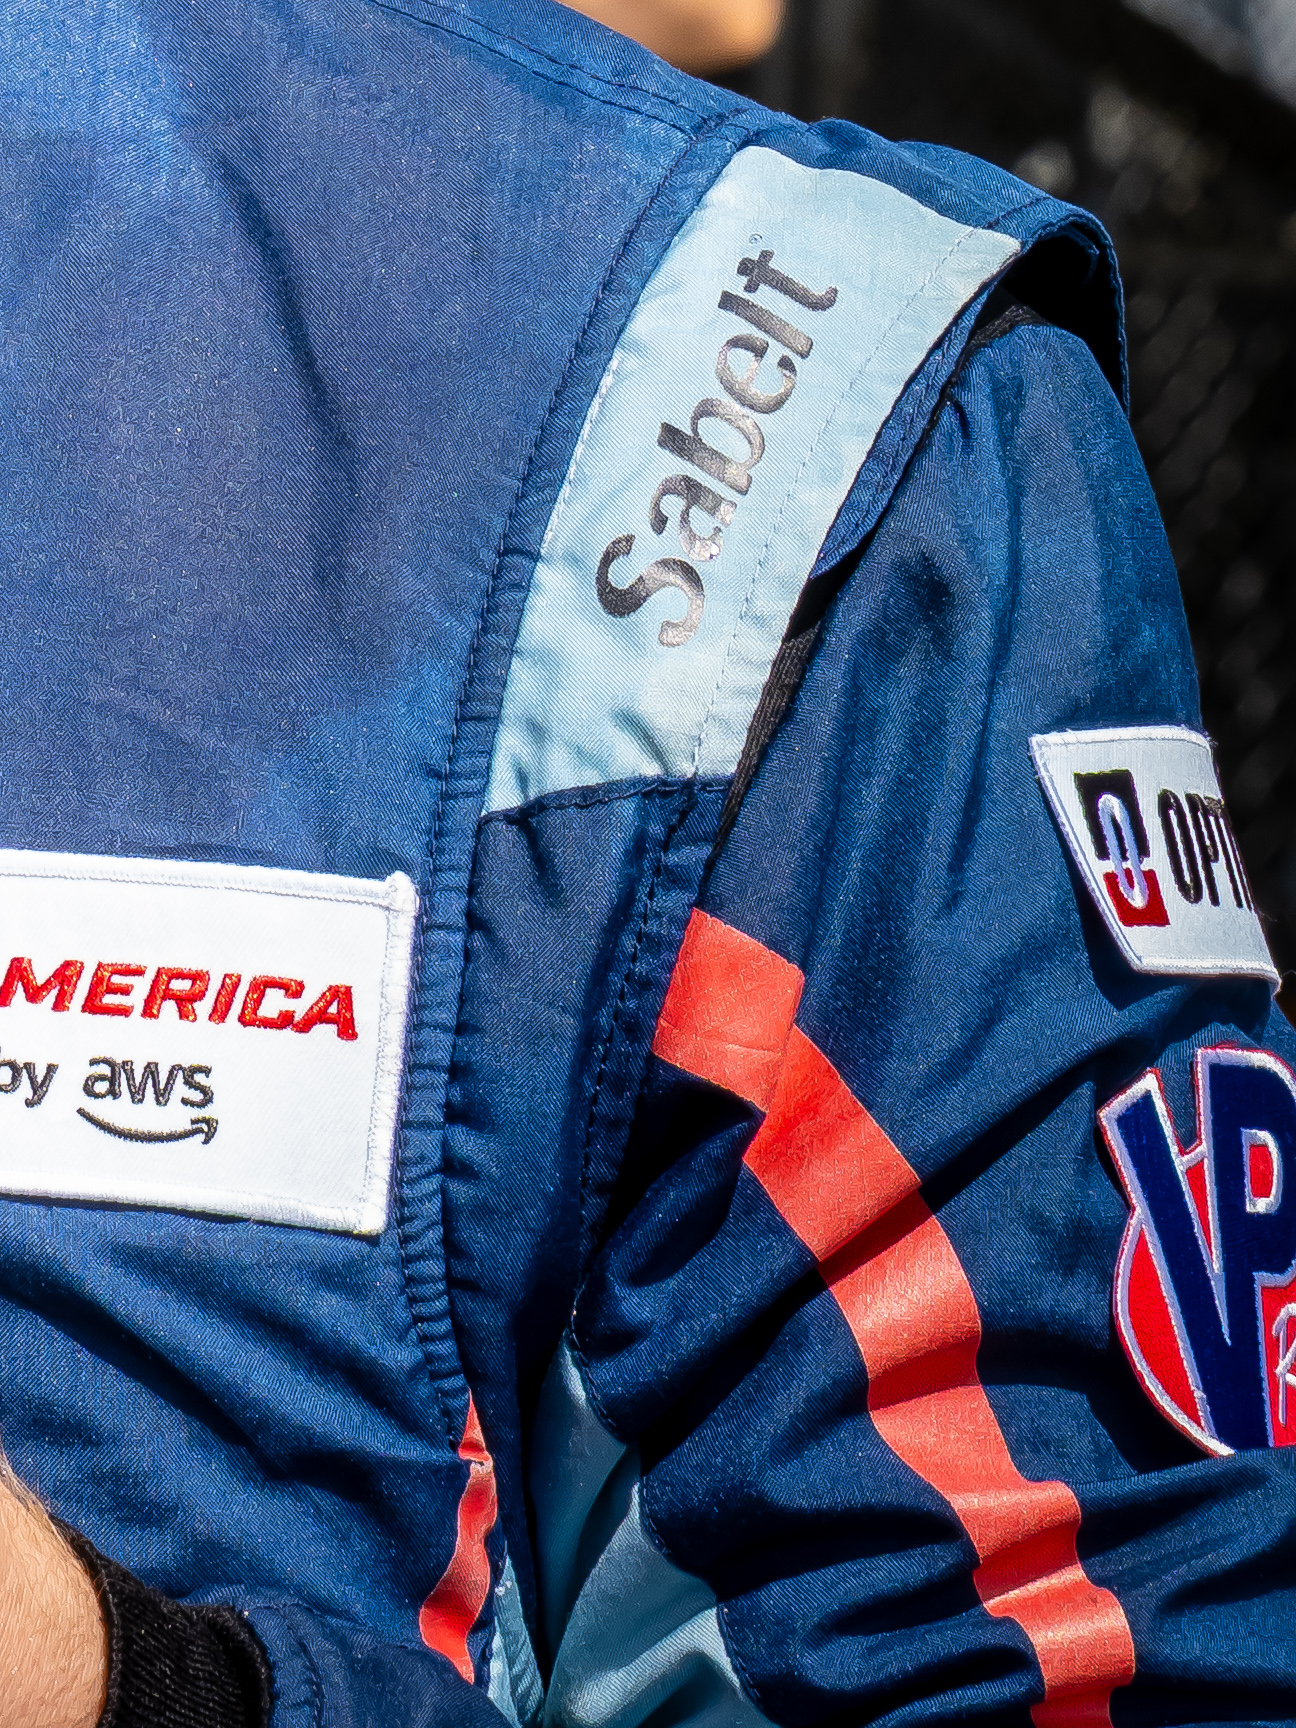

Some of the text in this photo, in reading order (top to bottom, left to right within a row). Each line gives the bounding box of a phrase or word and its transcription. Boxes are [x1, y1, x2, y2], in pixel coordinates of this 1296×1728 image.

[596, 239, 838, 648] Sabelt
[82, 1054, 216, 1110] aws
[1098, 1046, 1296, 1456] VP
